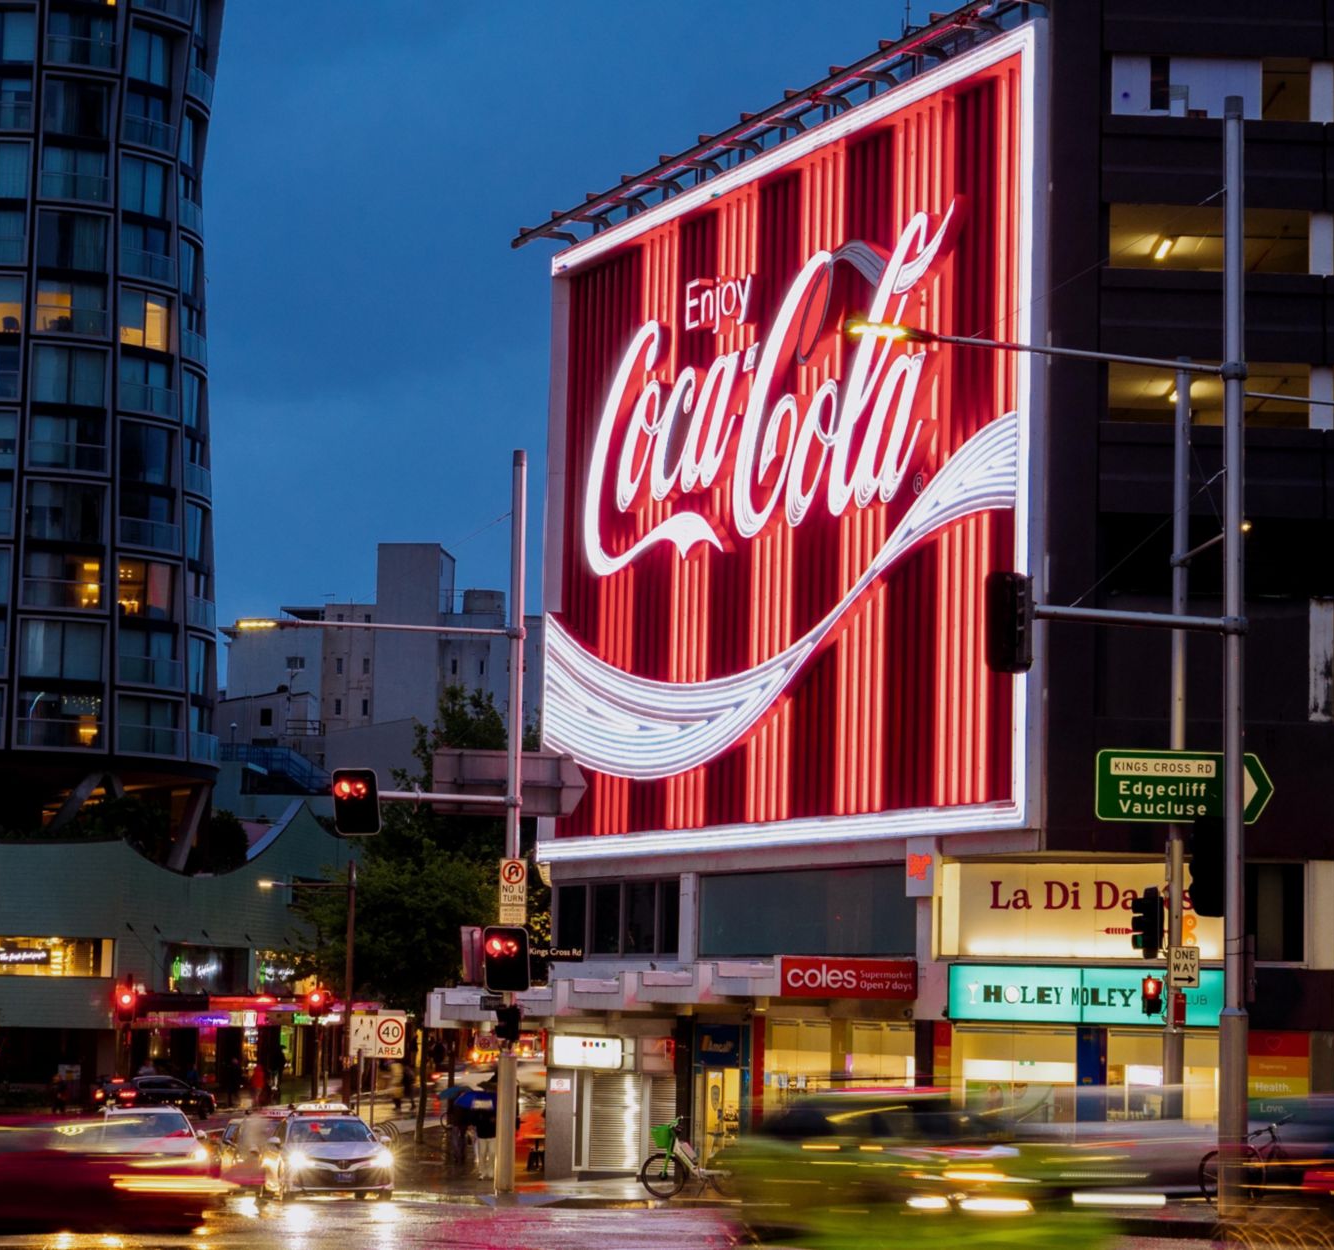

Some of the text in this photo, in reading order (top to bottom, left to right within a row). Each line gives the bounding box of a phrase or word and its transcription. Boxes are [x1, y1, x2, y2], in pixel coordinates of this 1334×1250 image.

[685, 273, 752, 333] Enjoy
[1114, 761, 1212, 774] KINGS CROSS RD
[1118, 780, 1207, 799] Edgecliff
[1118, 799, 1207, 815] Vaucluse
[502, 885, 525, 894] NO U
[989, 880, 1194, 910] La Di Das
[503, 894, 524, 902] TURN
[529, 947, 582, 957] Kings Cross Rd
[1174, 950, 1195, 960] ONE
[1173, 963, 1197, 973] WAY
[787, 963, 913, 989] coles Supermarket
[859, 981, 913, 992] Open 7 days
[982, 984, 1064, 1004] HOLEY
[1071, 987, 1137, 1008] MOLEY
[381, 1026, 400, 1038] 40
[377, 1047, 403, 1056] AREA
[1254, 1082, 1292, 1093] Health.
[1259, 1102, 1287, 1114] Love.
